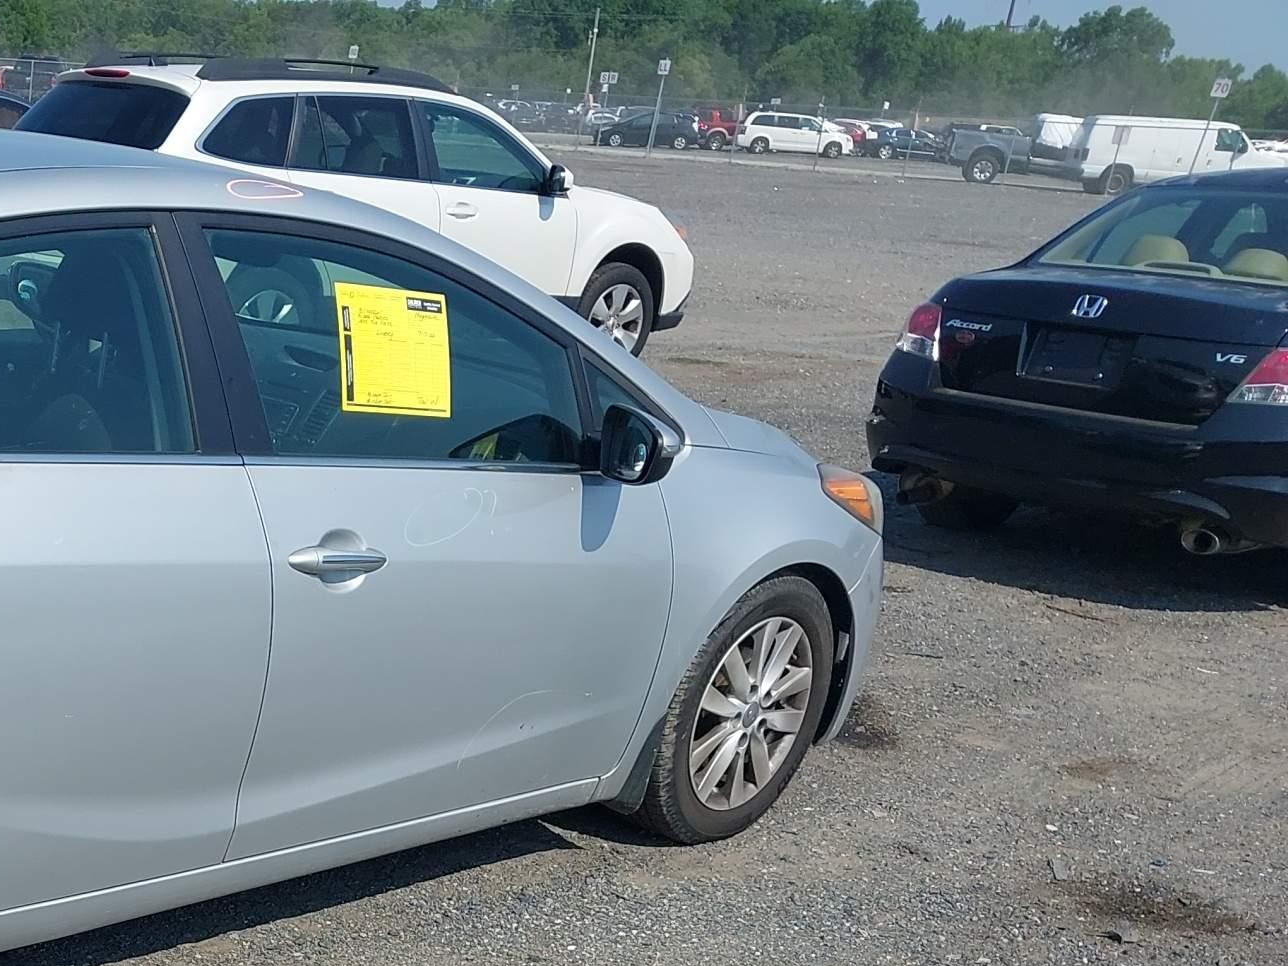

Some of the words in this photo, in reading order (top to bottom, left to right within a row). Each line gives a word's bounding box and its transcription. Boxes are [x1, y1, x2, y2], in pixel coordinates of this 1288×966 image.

[1213, 81, 1230, 95] 70
[945, 318, 993, 332] Accord
[1216, 352, 1248, 364] V6
